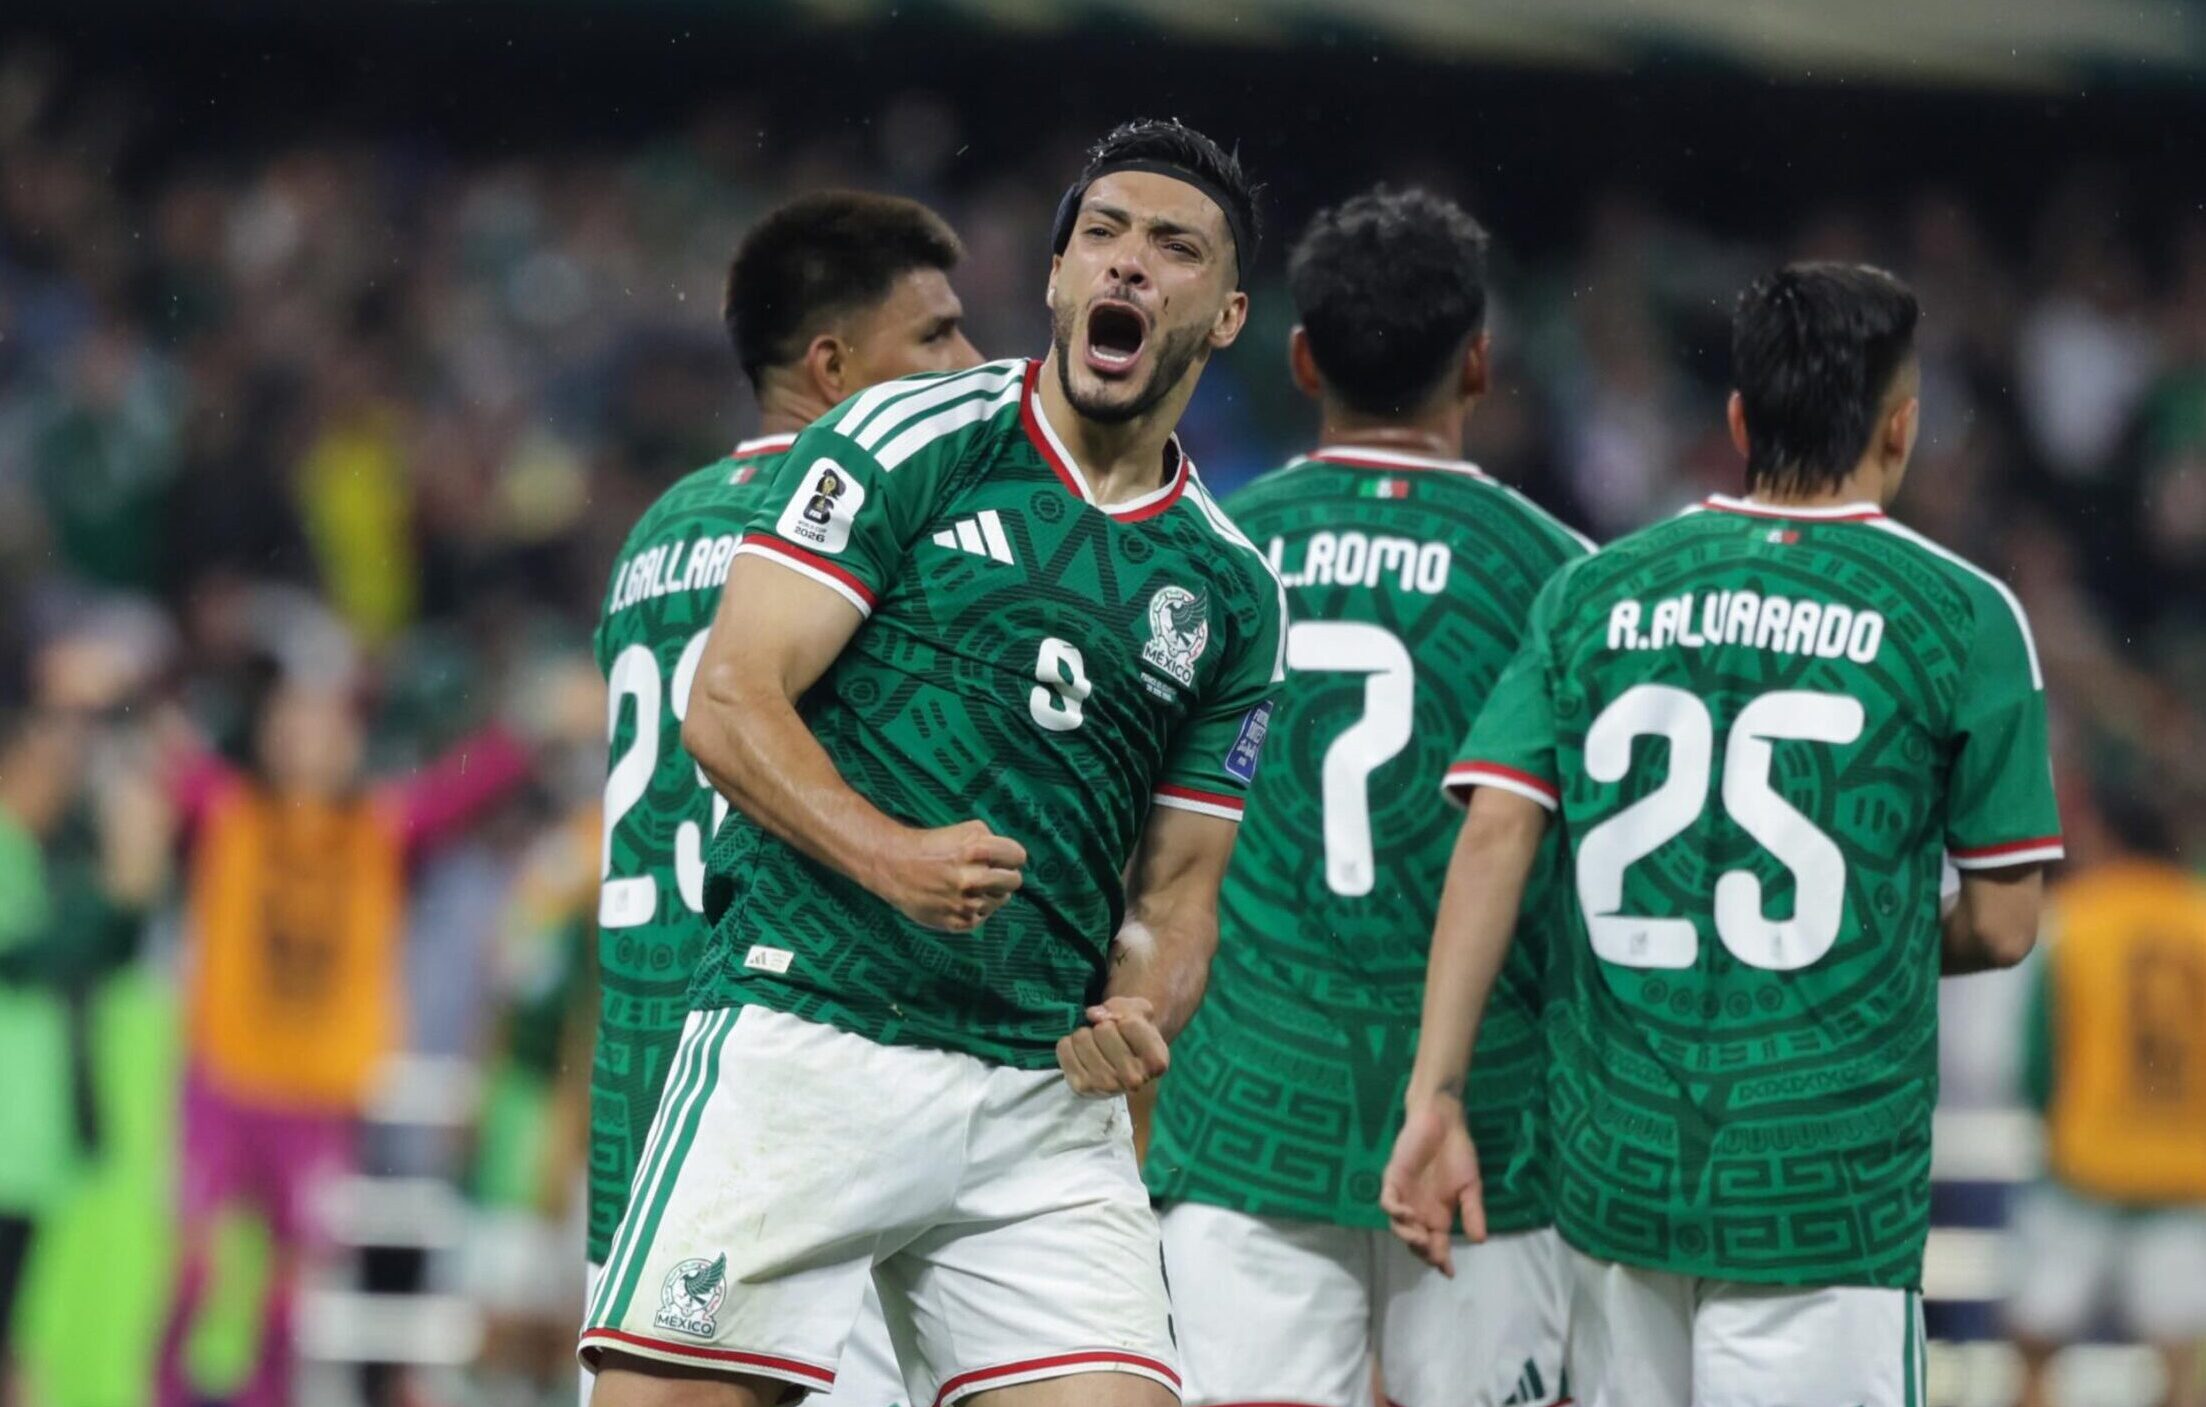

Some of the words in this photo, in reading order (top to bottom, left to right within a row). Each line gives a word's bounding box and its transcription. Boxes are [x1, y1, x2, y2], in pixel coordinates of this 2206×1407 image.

[794, 525, 826, 543] 2026
[1268, 531, 1452, 594] L.ROMO
[1607, 590, 1885, 664] R.ALVARADO
[1029, 637, 1092, 731] 9
[1144, 646, 1192, 683] MÉXICO
[1286, 620, 1414, 897] 7
[1576, 683, 1865, 970] 25
[657, 1313, 713, 1335] MÉXICO
